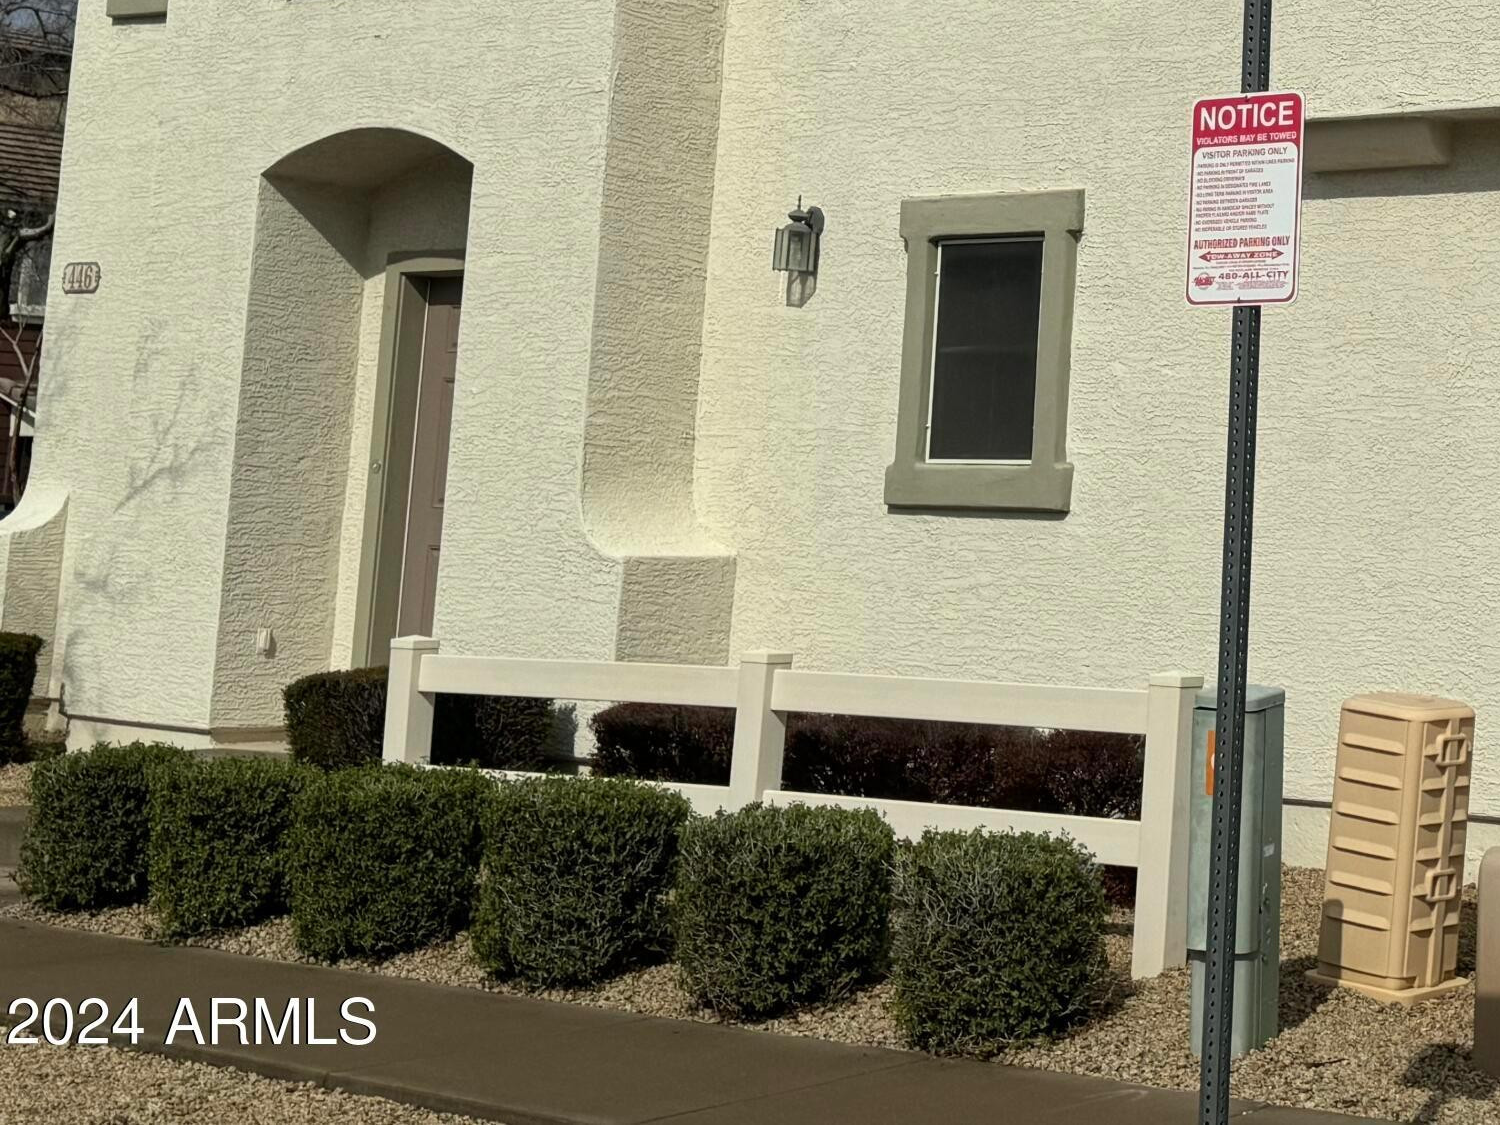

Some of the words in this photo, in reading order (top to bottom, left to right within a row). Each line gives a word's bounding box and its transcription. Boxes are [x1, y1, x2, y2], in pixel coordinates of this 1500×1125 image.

[1200, 101, 1294, 131] NOTICE
[1196, 135, 1238, 145] VIOLATORS
[1240, 134, 1255, 142] MAY
[1257, 133, 1267, 141] BE
[1270, 131, 1297, 140] TOWED
[1202, 150, 1231, 159] VISITOR
[1232, 148, 1266, 157] PARKING
[1268, 147, 1287, 155] ONLY
[1193, 238, 1238, 250] AUTHORIZED
[1239, 237, 1270, 248] PARKING
[1272, 235, 1290, 246] ONLY
[68, 265, 93, 289] 446
[1218, 271, 1289, 280] 480-ALL-CITY
